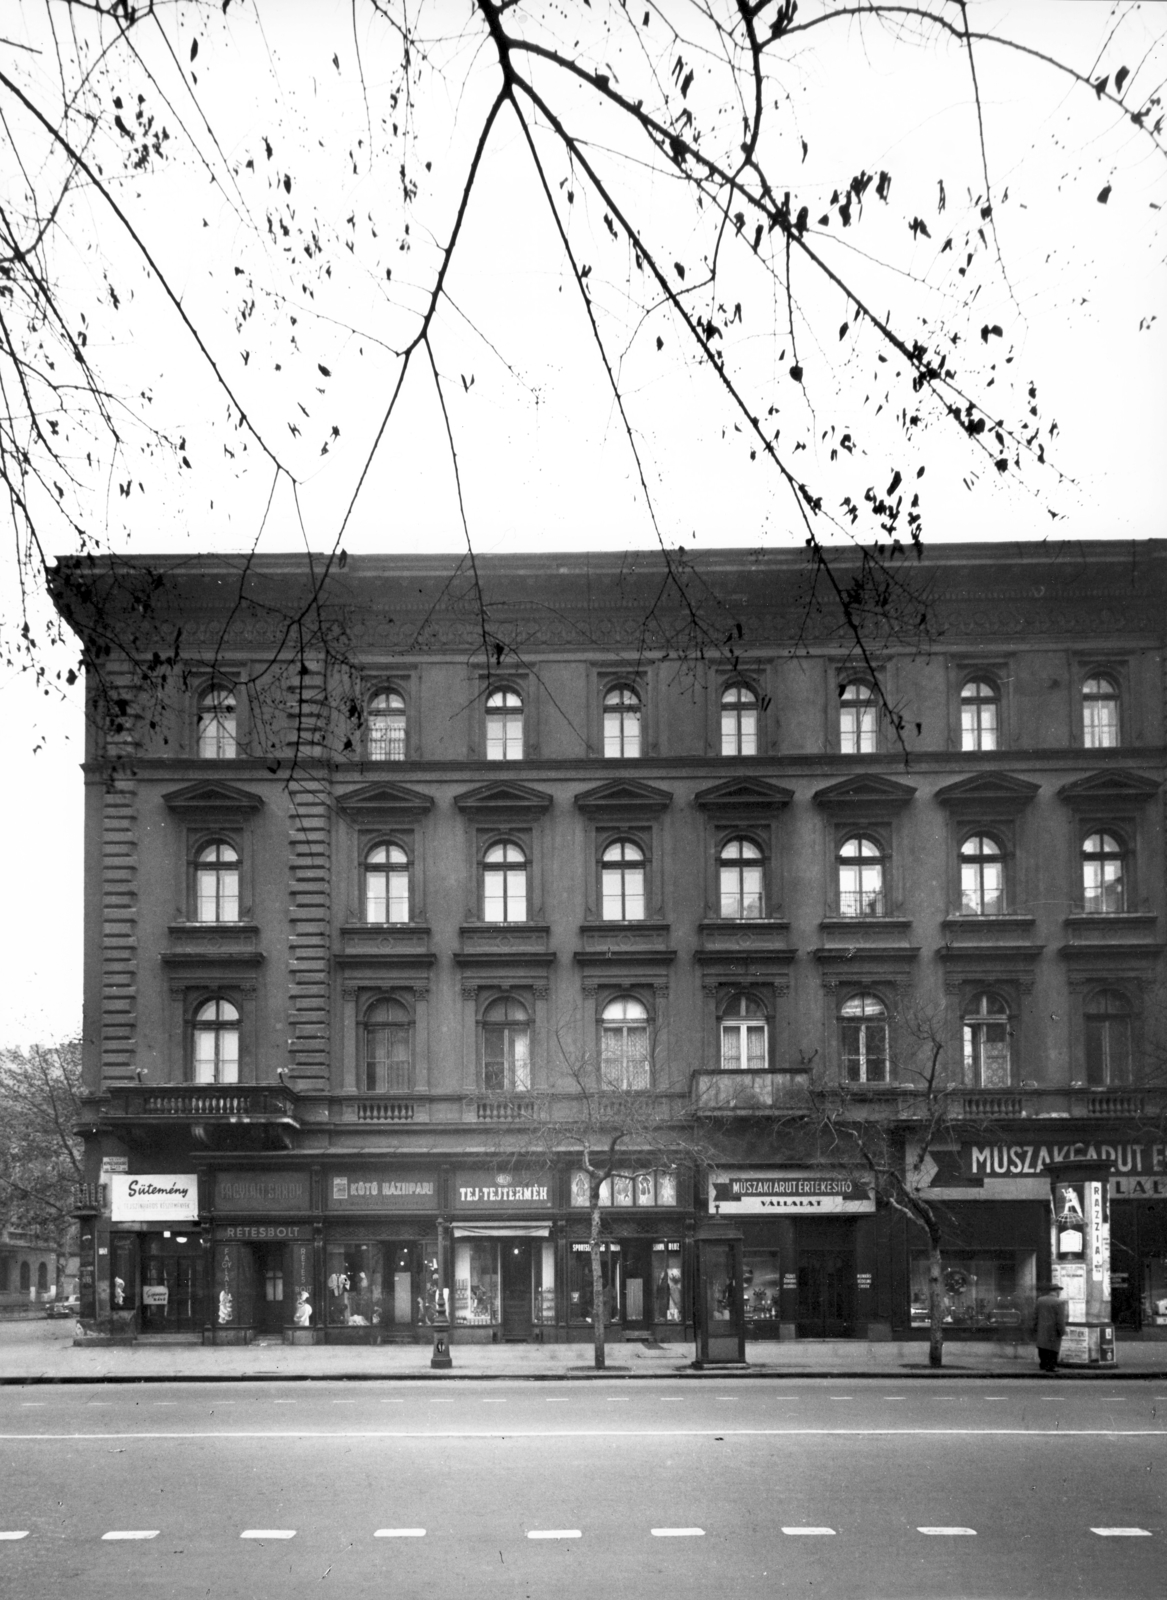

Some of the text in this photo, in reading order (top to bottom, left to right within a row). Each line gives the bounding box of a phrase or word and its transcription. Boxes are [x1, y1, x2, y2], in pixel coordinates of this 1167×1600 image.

[128, 1179, 189, 1198] Sütemény
[773, 1179, 797, 1193] ÁRUT
[760, 1198, 823, 1207] VÁLLALAT
[1093, 1186, 1101, 1255] RAZZIA
